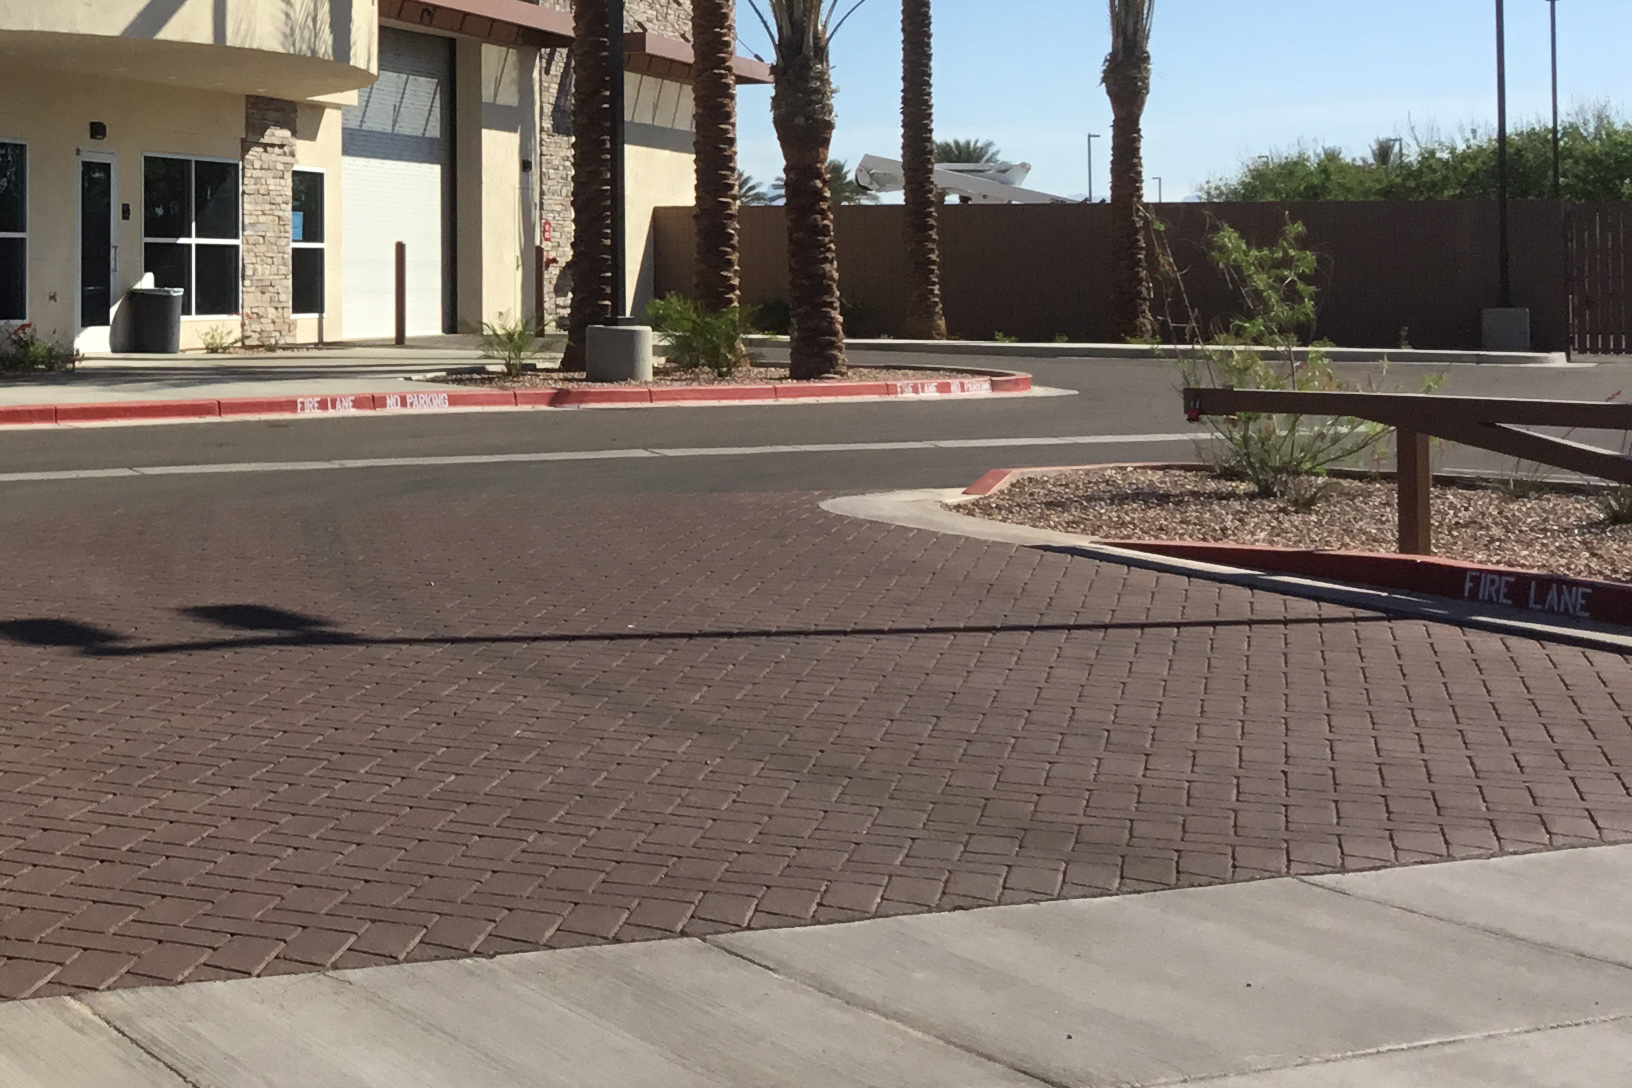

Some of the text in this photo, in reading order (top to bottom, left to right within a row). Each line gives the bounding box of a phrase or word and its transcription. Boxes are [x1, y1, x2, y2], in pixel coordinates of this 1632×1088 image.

[297, 393, 449, 413] FIRE LANE NO PARKING
[1464, 570, 1593, 618] FIRE LANE
